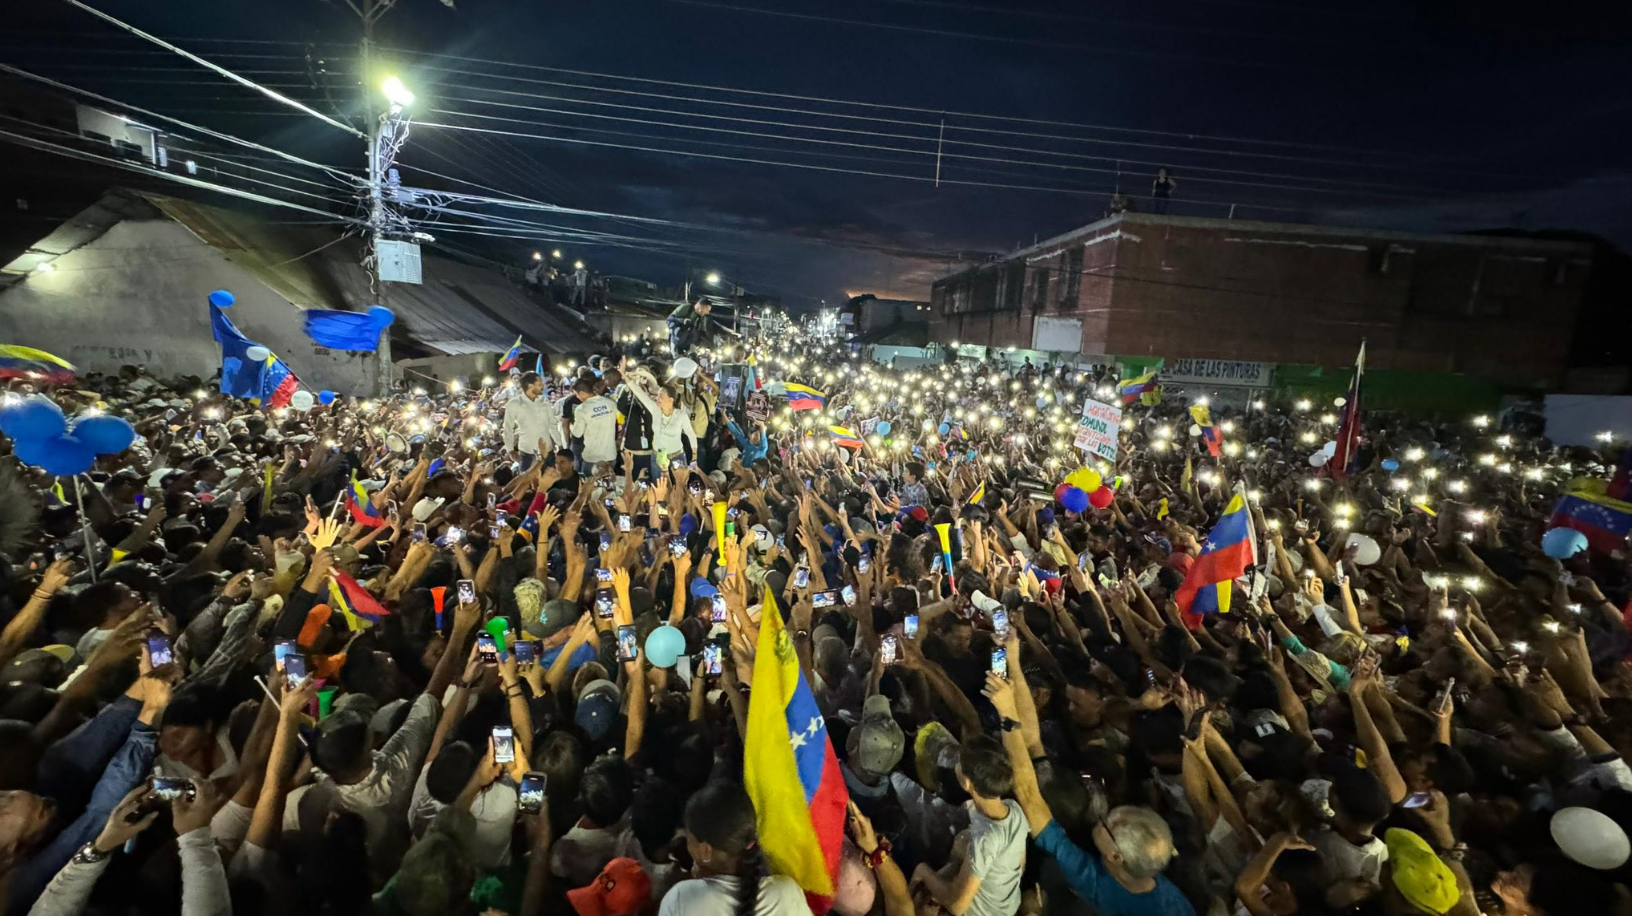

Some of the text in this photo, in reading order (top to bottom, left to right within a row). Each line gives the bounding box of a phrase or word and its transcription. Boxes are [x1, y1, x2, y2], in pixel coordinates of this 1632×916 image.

[1194, 361, 1205, 377] DE
[1206, 361, 1220, 379] LAS
[1221, 362, 1261, 380] PINTURAS
